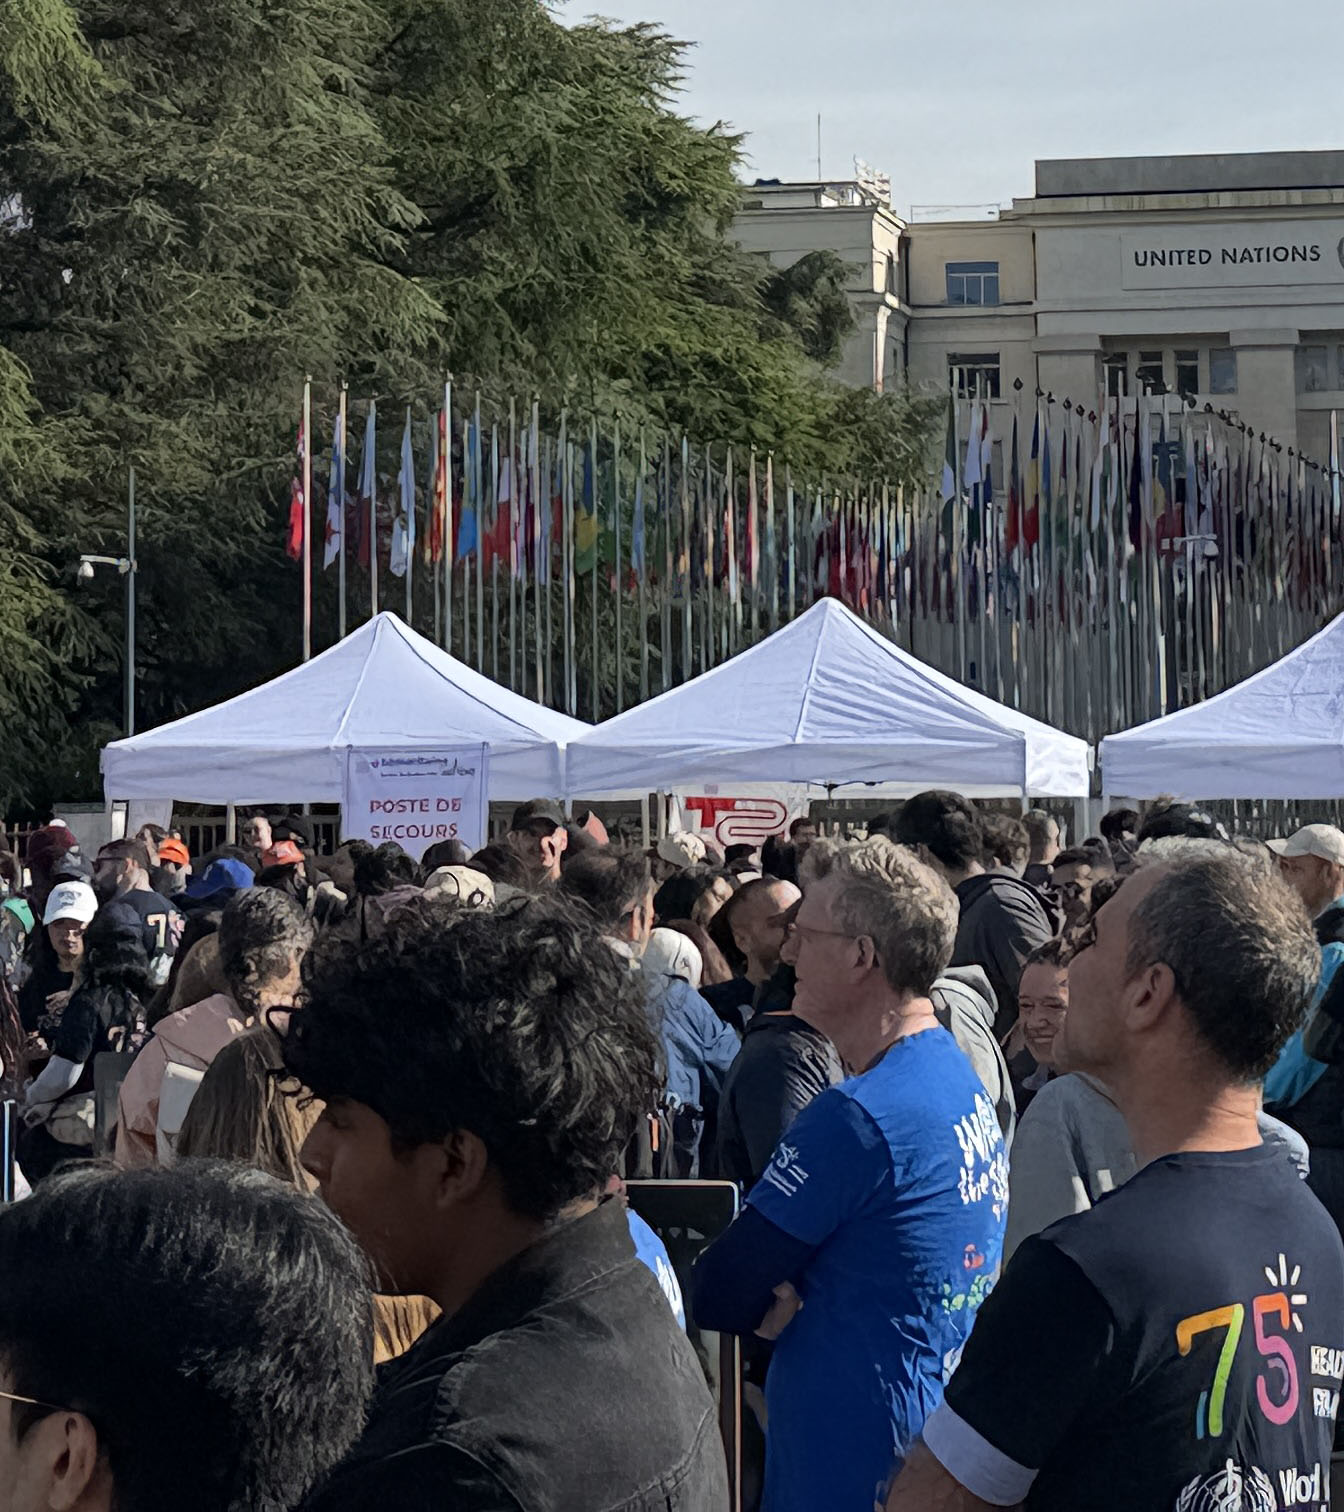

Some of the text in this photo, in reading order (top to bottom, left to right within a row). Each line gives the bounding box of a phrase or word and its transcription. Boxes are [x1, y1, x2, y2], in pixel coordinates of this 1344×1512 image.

[1134, 245, 1321, 267] UNITED NATIONS
[369, 798, 462, 813] POSTE DE
[370, 823, 458, 840] SECOURS
[1176, 1292, 1300, 1439] 75
